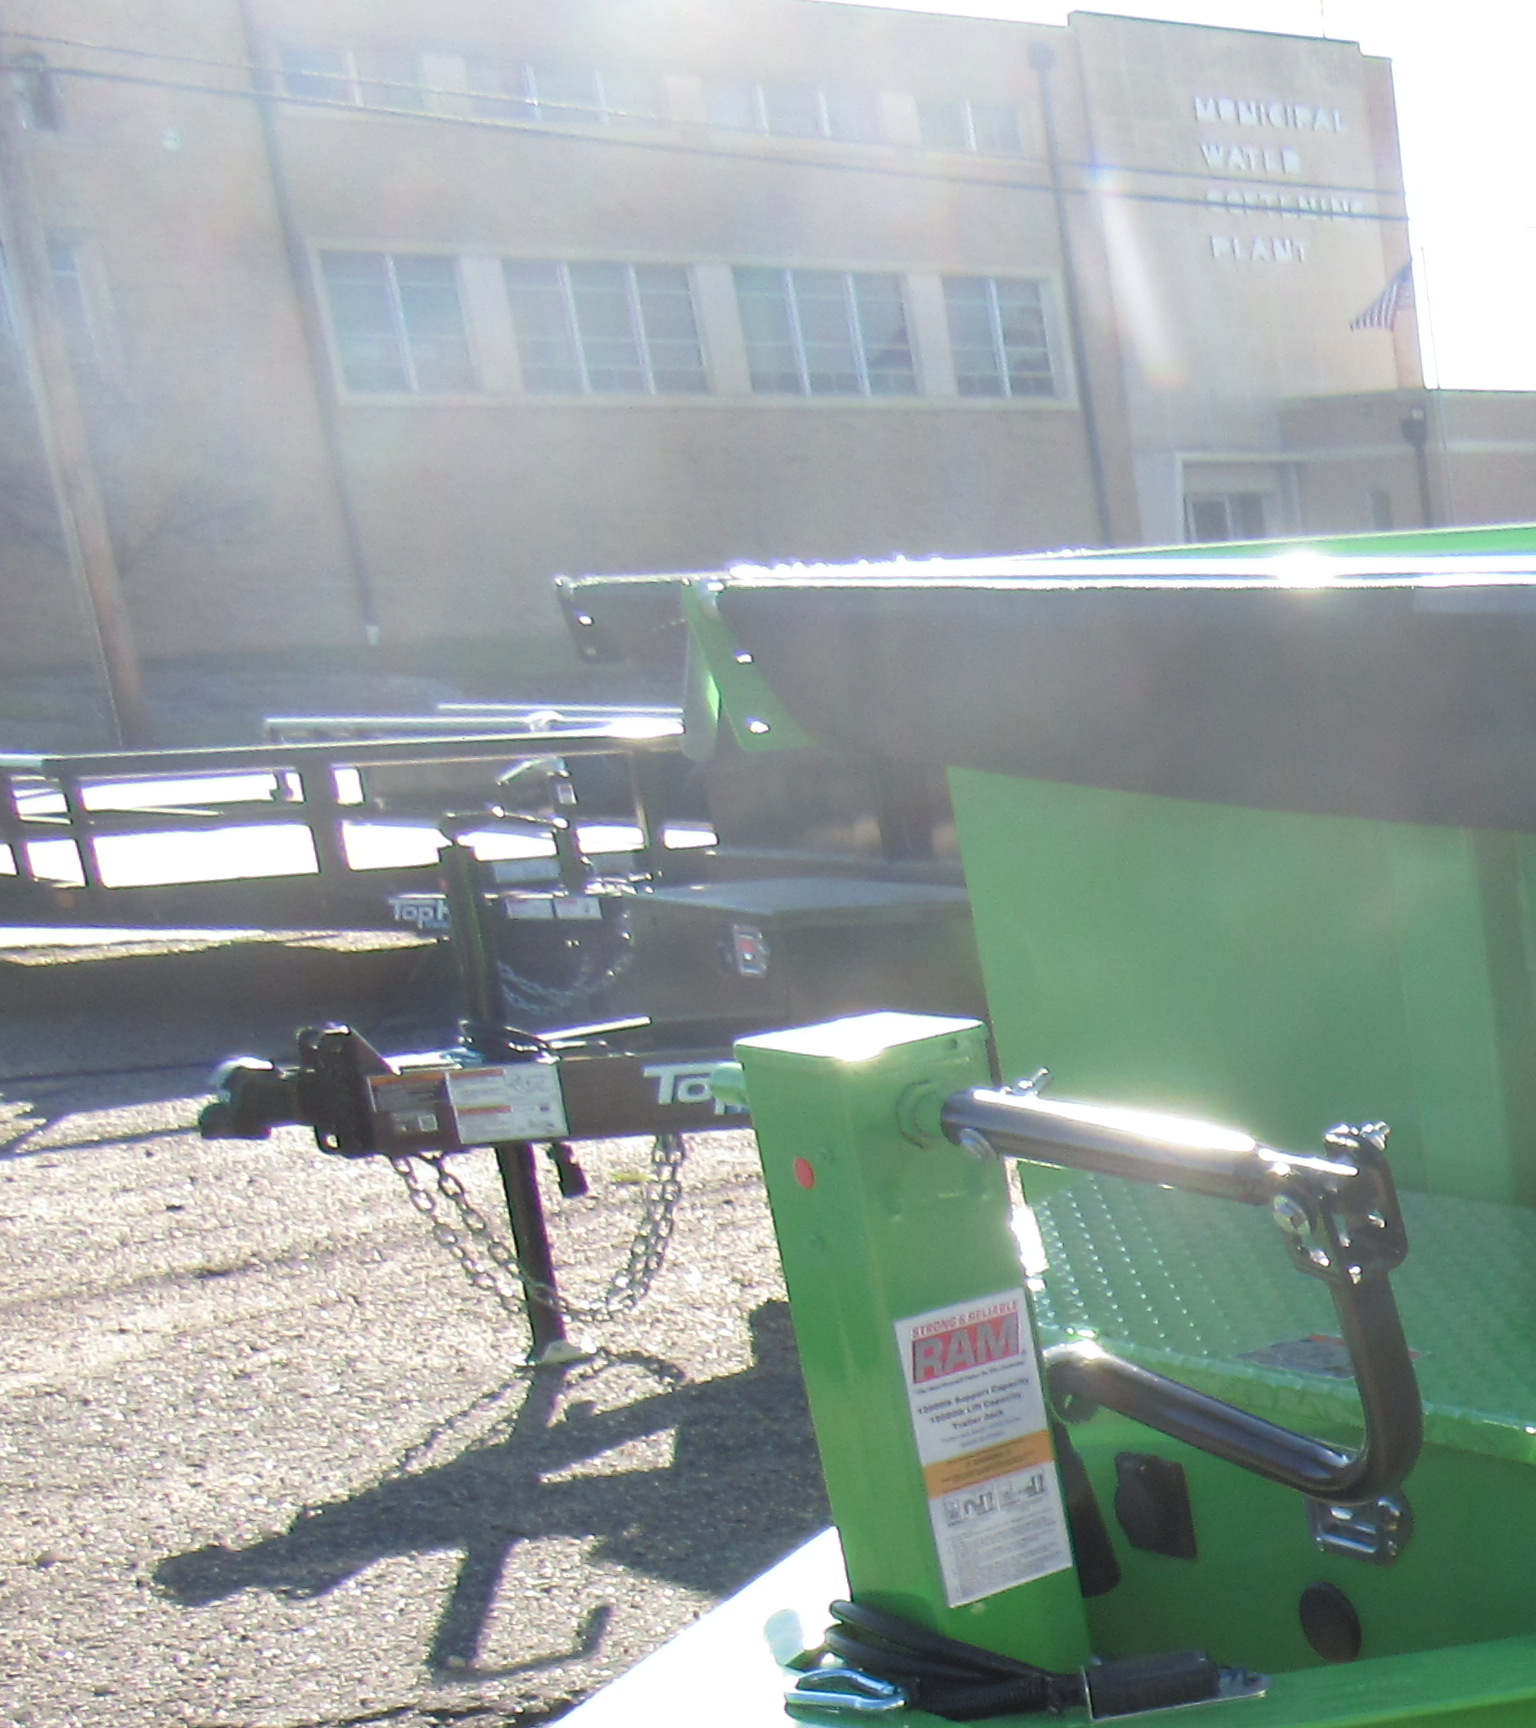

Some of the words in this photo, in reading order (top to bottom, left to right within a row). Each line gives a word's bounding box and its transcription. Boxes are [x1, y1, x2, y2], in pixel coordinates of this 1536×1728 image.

[1194, 97, 1348, 133] MUNICIPAL
[1201, 144, 1300, 174] WATER
[1210, 234, 1306, 264] PLANT
[912, 1313, 1019, 1384] RAM
[990, 1378, 1029, 1393] Capacity
